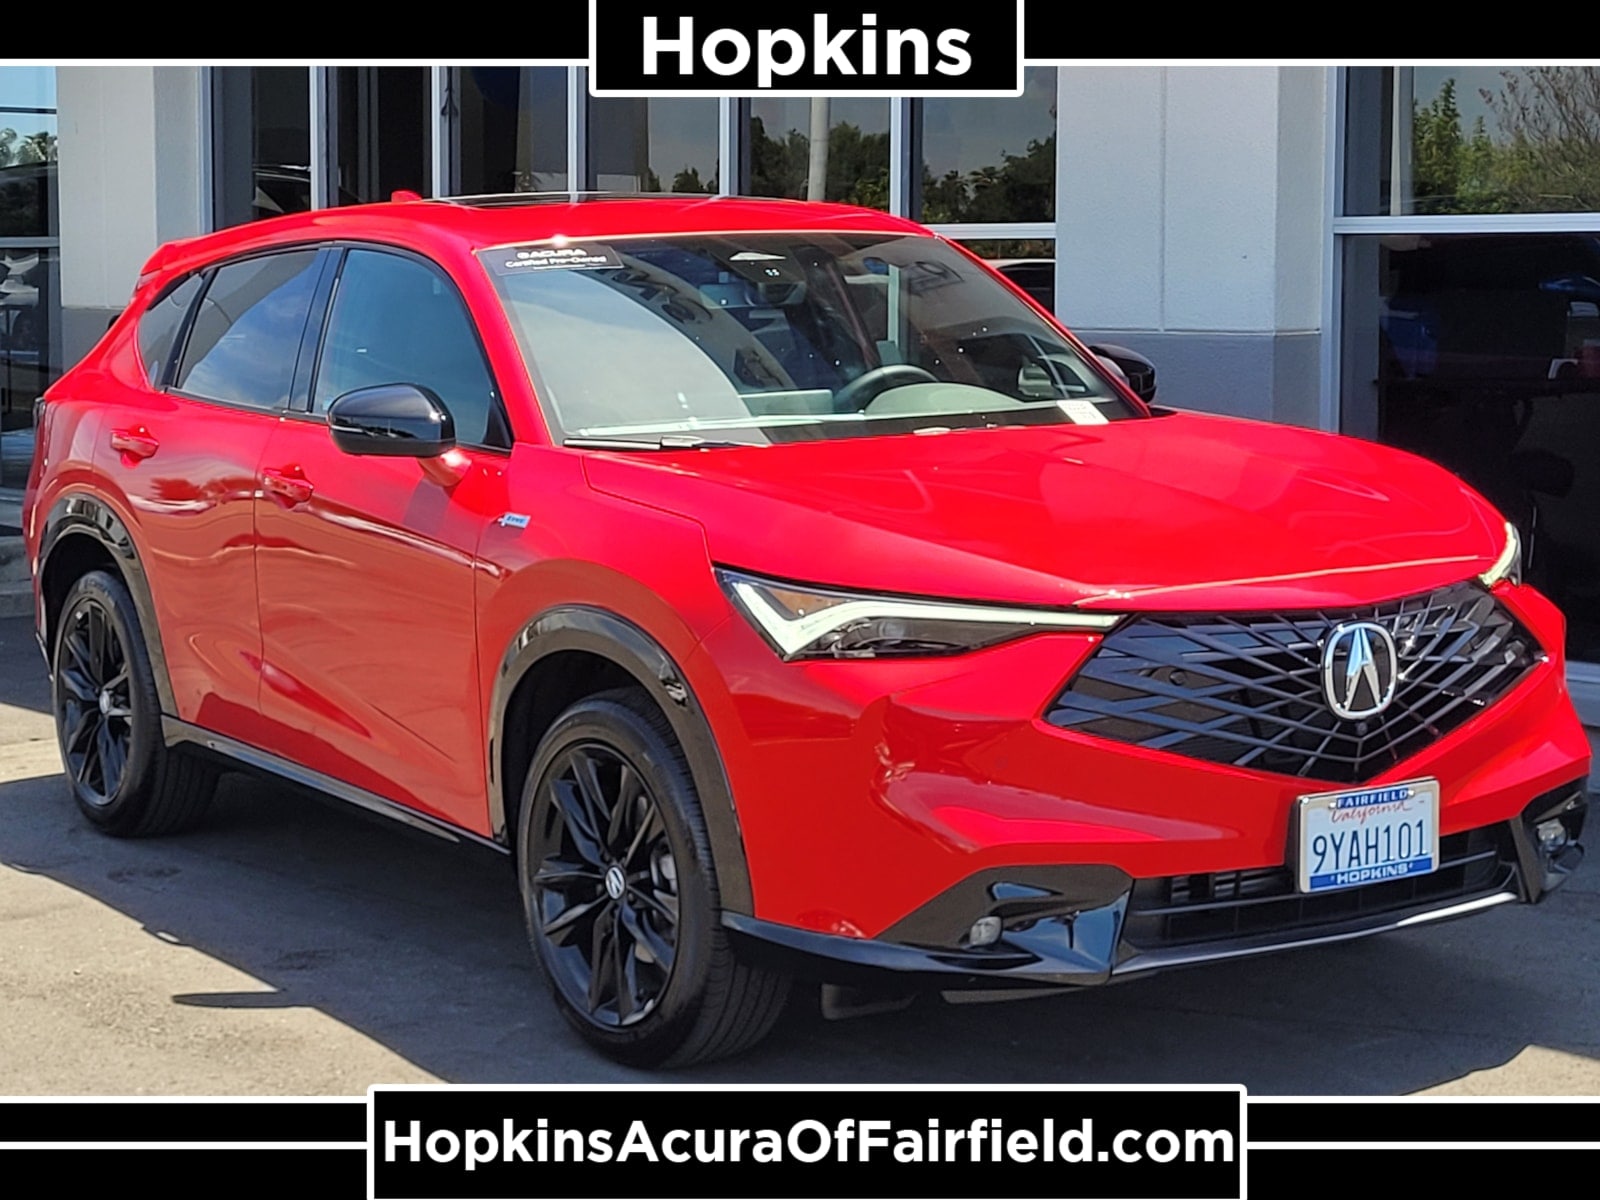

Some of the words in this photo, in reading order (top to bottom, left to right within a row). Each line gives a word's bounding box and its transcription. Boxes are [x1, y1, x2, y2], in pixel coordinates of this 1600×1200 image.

[1337, 789, 1408, 808] FAIRFIELD
[1331, 800, 1412, 824] California
[1312, 819, 1427, 874] 9YAH101
[1336, 863, 1409, 885] HOPKINS
